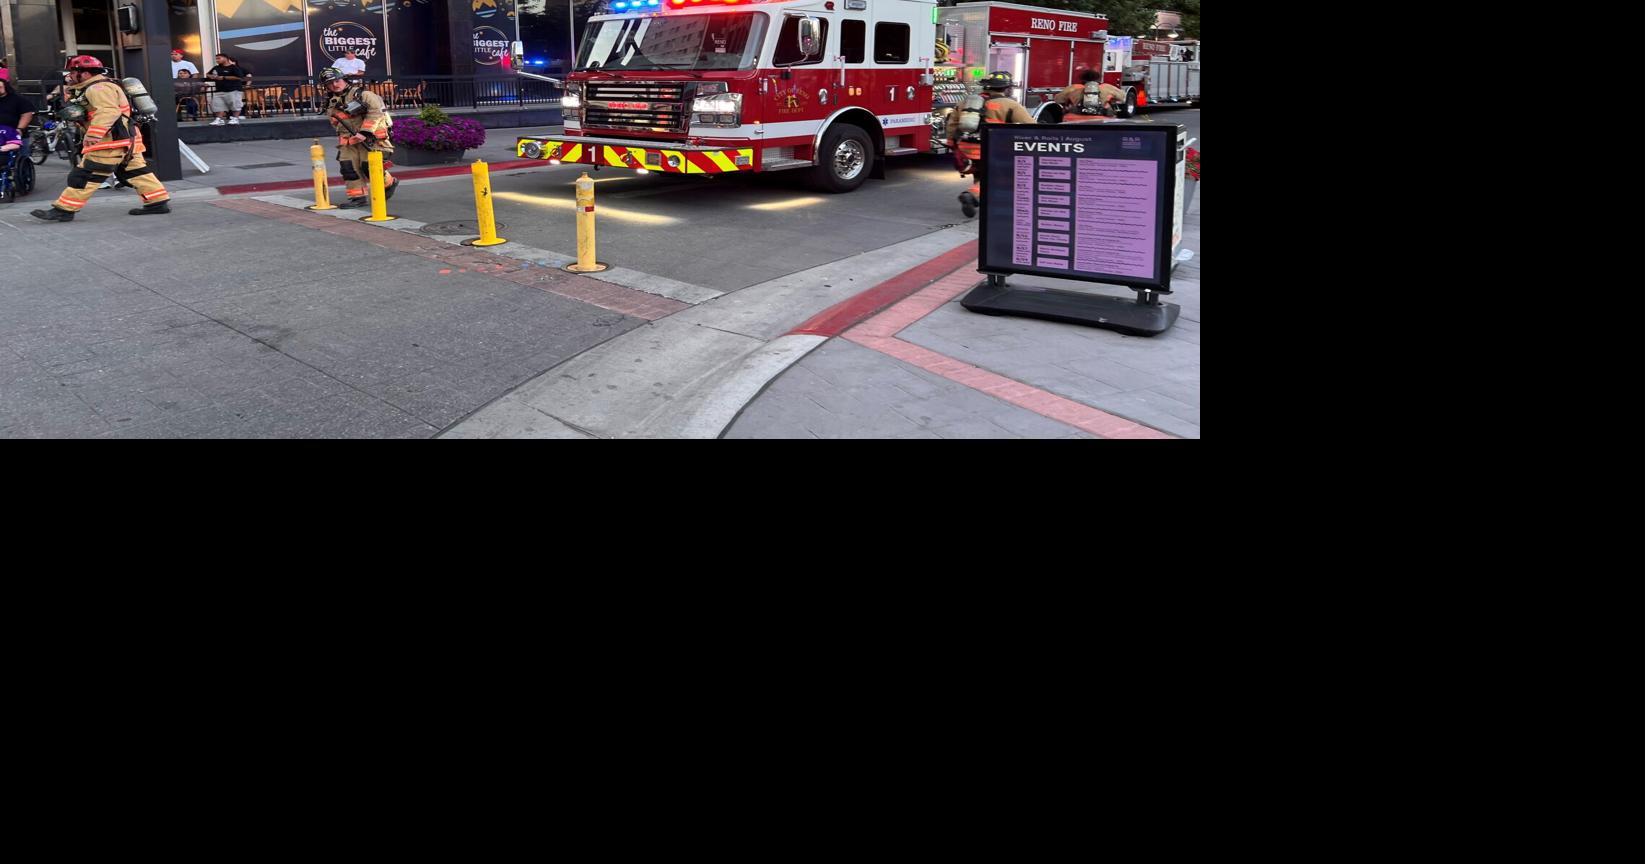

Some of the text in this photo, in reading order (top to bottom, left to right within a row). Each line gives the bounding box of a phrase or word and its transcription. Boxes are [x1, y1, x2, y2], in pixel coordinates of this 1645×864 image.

[1031, 17, 1078, 32] RENO FIRE
[323, 27, 338, 36] the
[324, 37, 377, 46] BIGGEST
[889, 87, 895, 102] 1
[1013, 141, 1085, 153] EVENTS
[587, 145, 596, 163] 1
